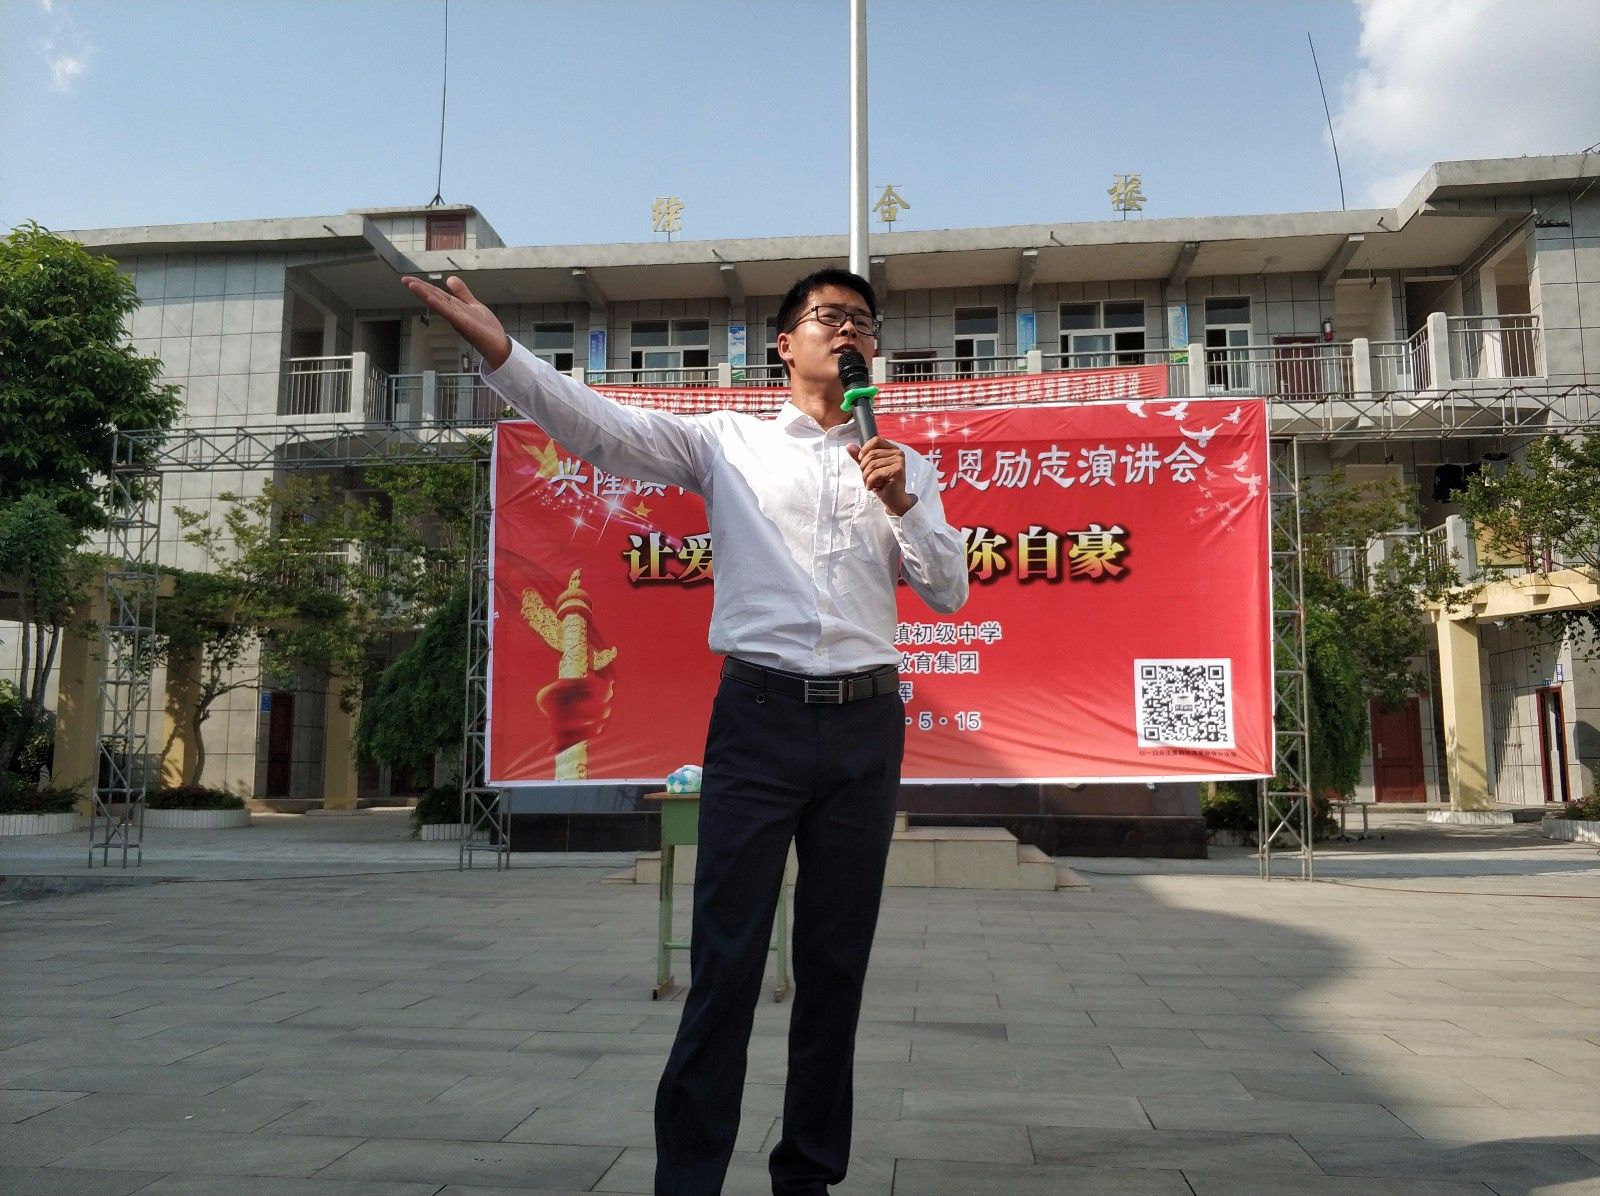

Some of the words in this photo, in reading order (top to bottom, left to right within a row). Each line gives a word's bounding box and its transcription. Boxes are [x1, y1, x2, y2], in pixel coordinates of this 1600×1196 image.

[550, 457, 686, 497] 兴隆
[622, 532, 713, 583] 让爱
[959, 523, 1126, 581] 你自豪
[895, 622, 1001, 645] 镇初级中学
